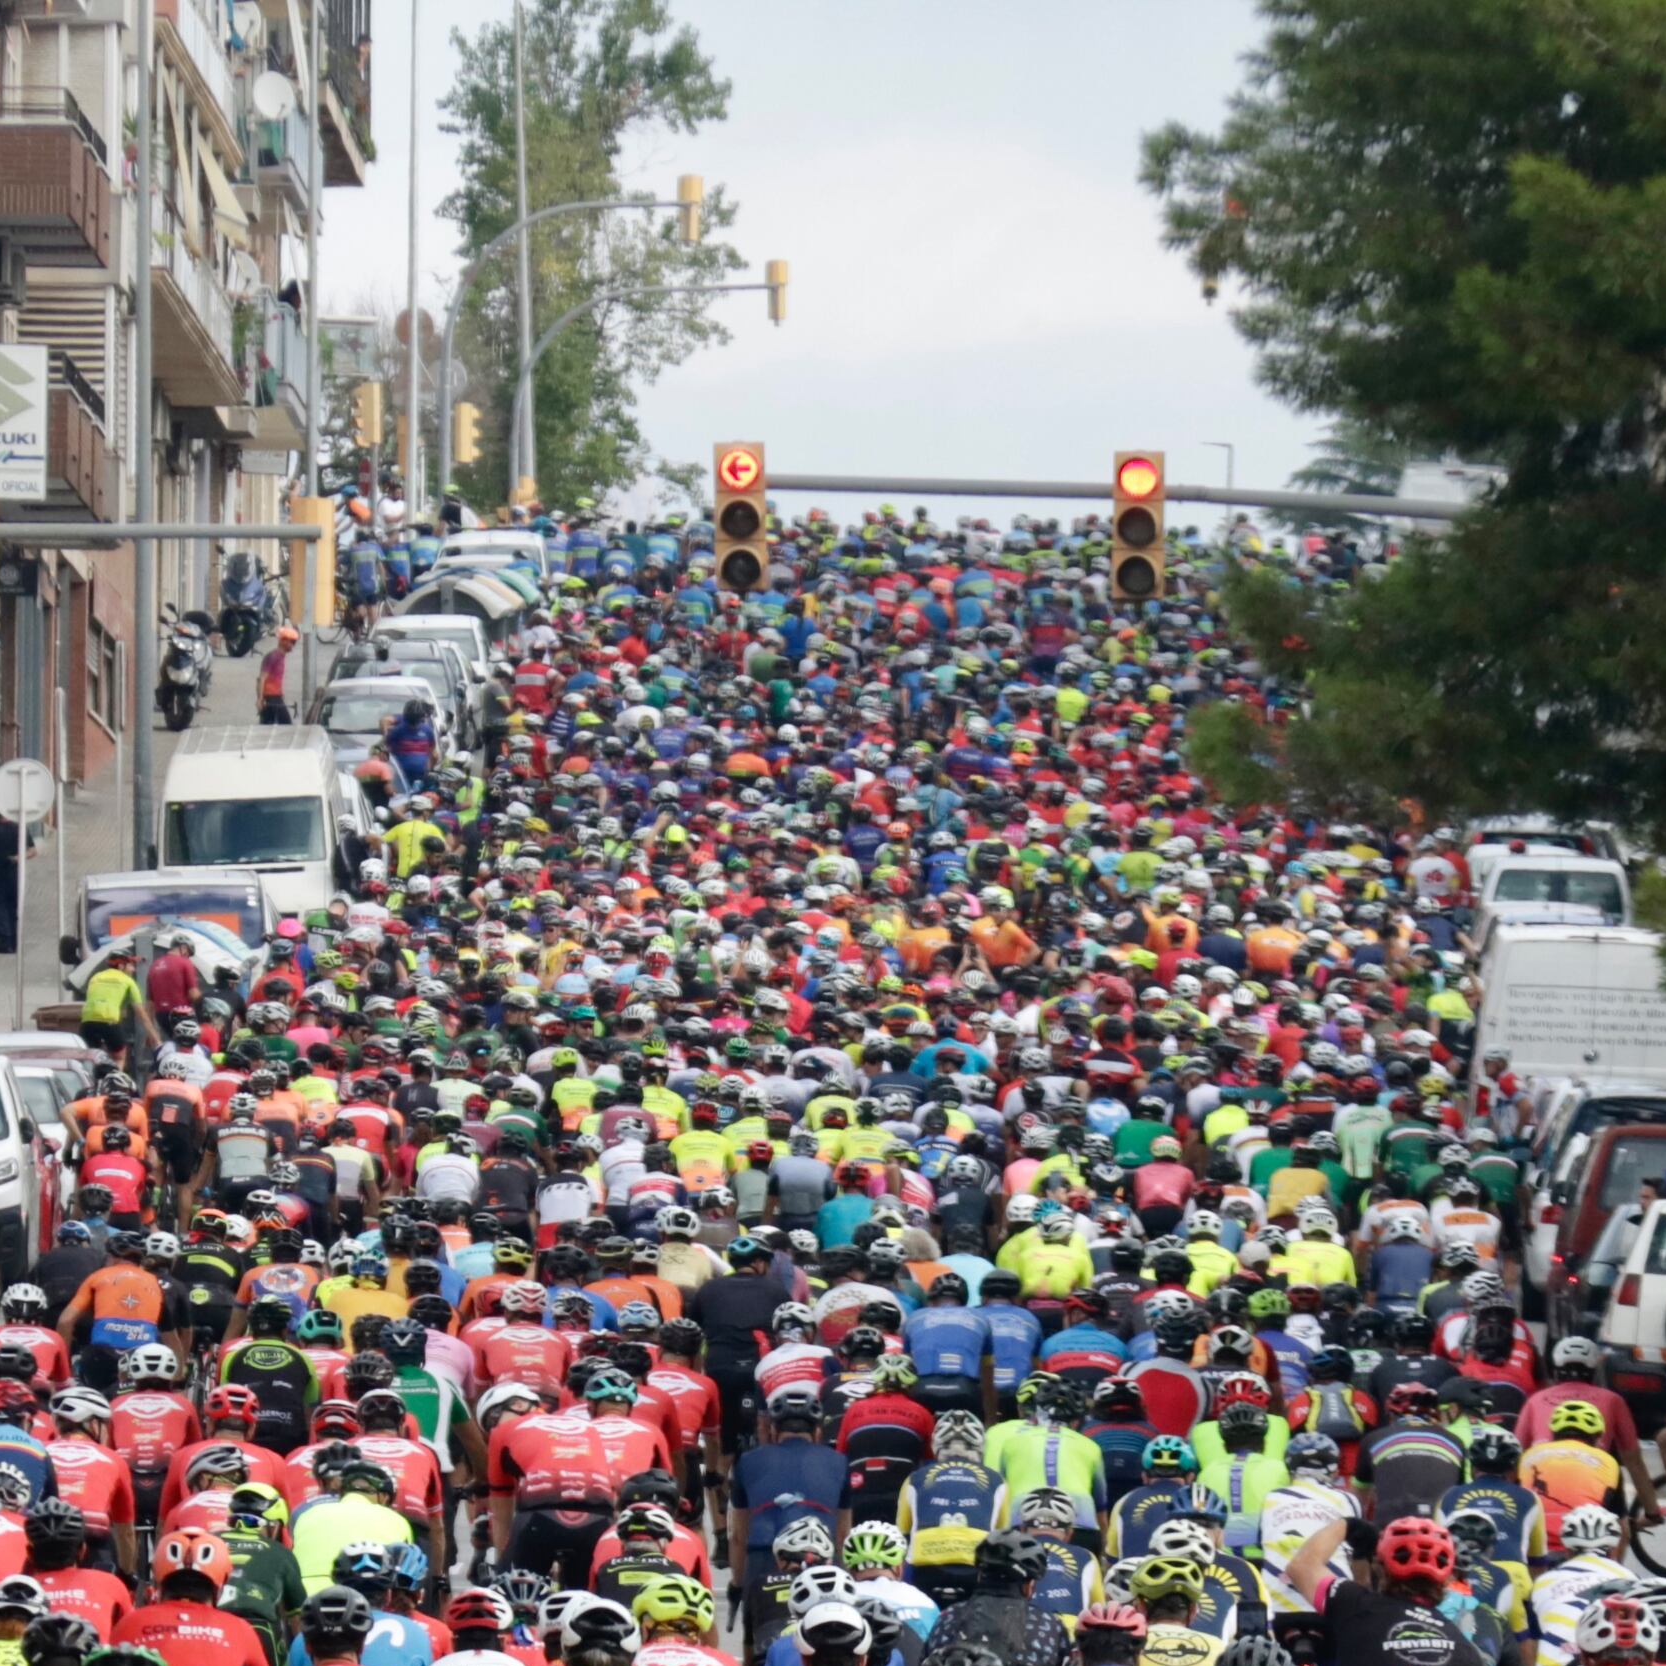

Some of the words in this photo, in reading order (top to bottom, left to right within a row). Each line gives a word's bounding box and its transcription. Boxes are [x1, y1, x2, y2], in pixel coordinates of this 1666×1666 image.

[1, 480, 41, 493] OFICIAL
[44, 1588, 86, 1600] BIKE
[896, 1608, 922, 1621] IN
[141, 1624, 225, 1638] CORBIKE
